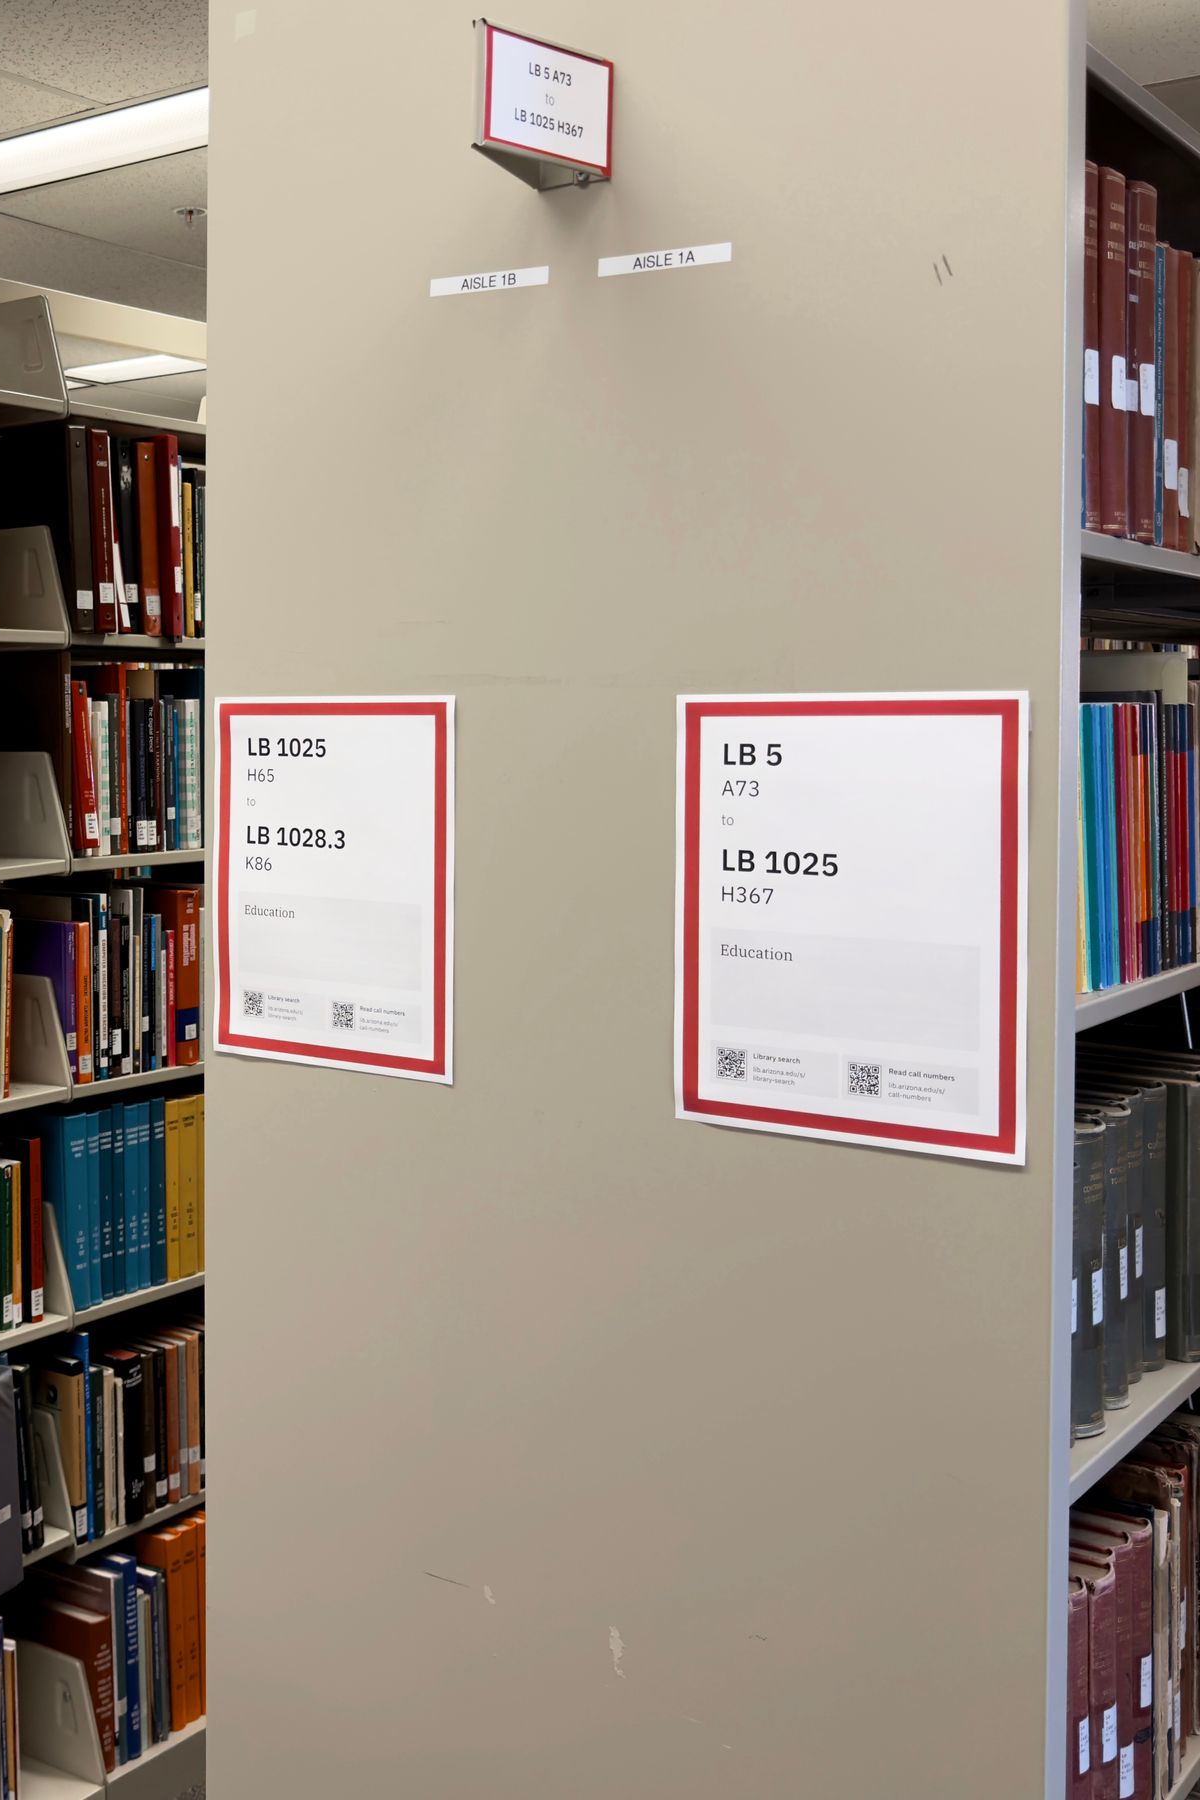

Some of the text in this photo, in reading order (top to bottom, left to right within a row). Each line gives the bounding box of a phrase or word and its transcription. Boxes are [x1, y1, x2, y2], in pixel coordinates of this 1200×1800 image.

[529, 62, 572, 87] LB 5 A73
[545, 92, 555, 107] to
[514, 107, 584, 138] LB 1025 H367
[633, 251, 696, 270] AISLE 1A
[461, 273, 517, 291] AISLE 1B
[247, 737, 327, 757] LB 1025
[723, 743, 782, 767] LB 5
[247, 768, 275, 782] H65
[721, 780, 760, 797] A73
[246, 797, 256, 807] to
[721, 814, 734, 826] to
[246, 825, 346, 849] LB 1028.3
[245, 856, 272, 871] K86
[722, 849, 838, 877] LB 1025
[721, 886, 774, 905] H367
[244, 904, 295, 919] Education
[720, 944, 793, 962] Education
[753, 1053, 800, 1064] Library search
[888, 1068, 955, 1082] Read call numbers
